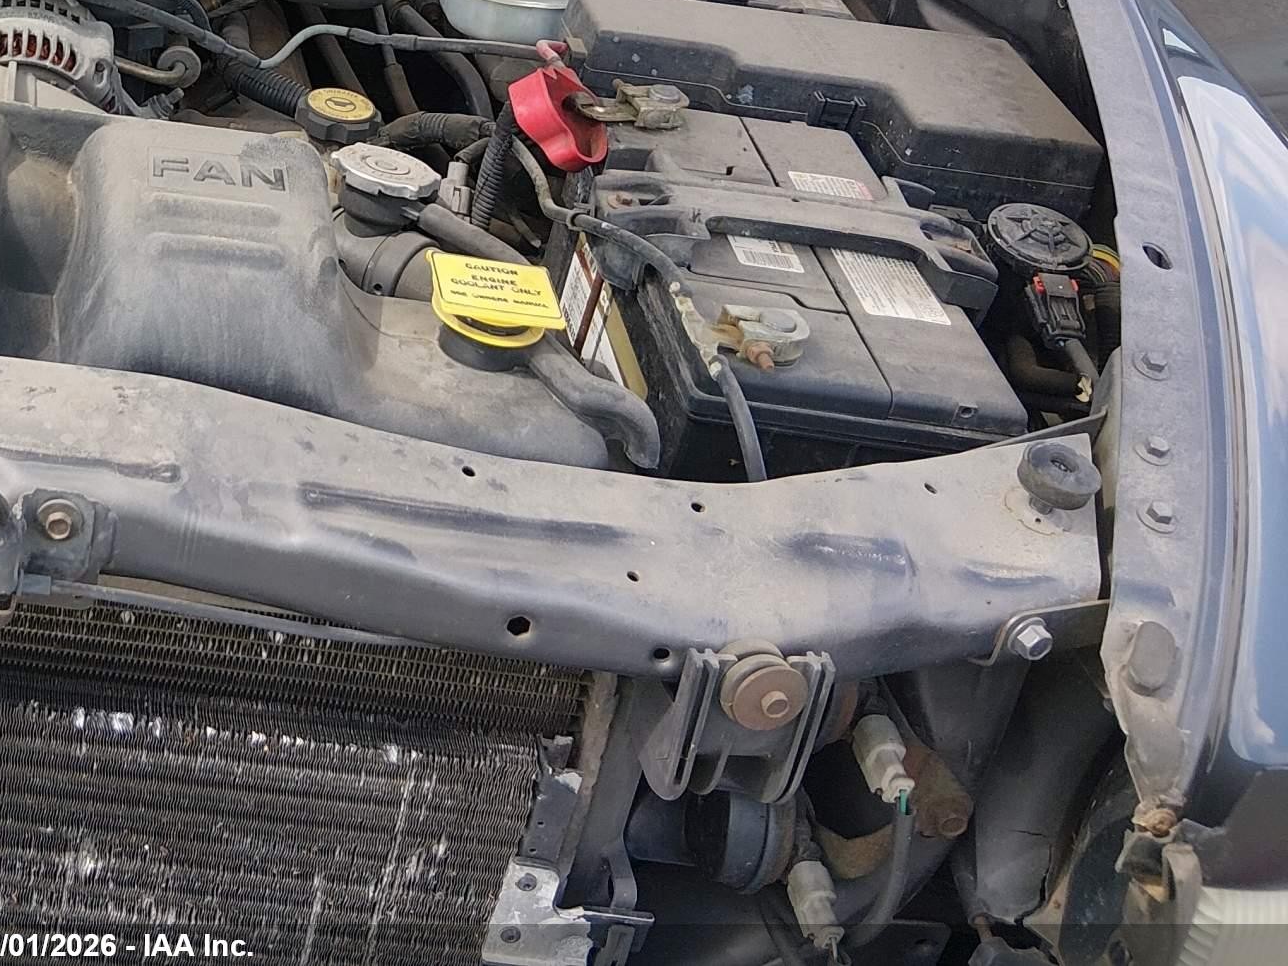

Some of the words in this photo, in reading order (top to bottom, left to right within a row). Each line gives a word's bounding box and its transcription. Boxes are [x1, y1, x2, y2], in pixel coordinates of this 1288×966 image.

[152, 155, 286, 192] FAN
[465, 263, 518, 276] CAUTION
[450, 277, 505, 291] COOLANT
[511, 286, 542, 297] ONLY
[472, 274, 518, 287] ENGINE
